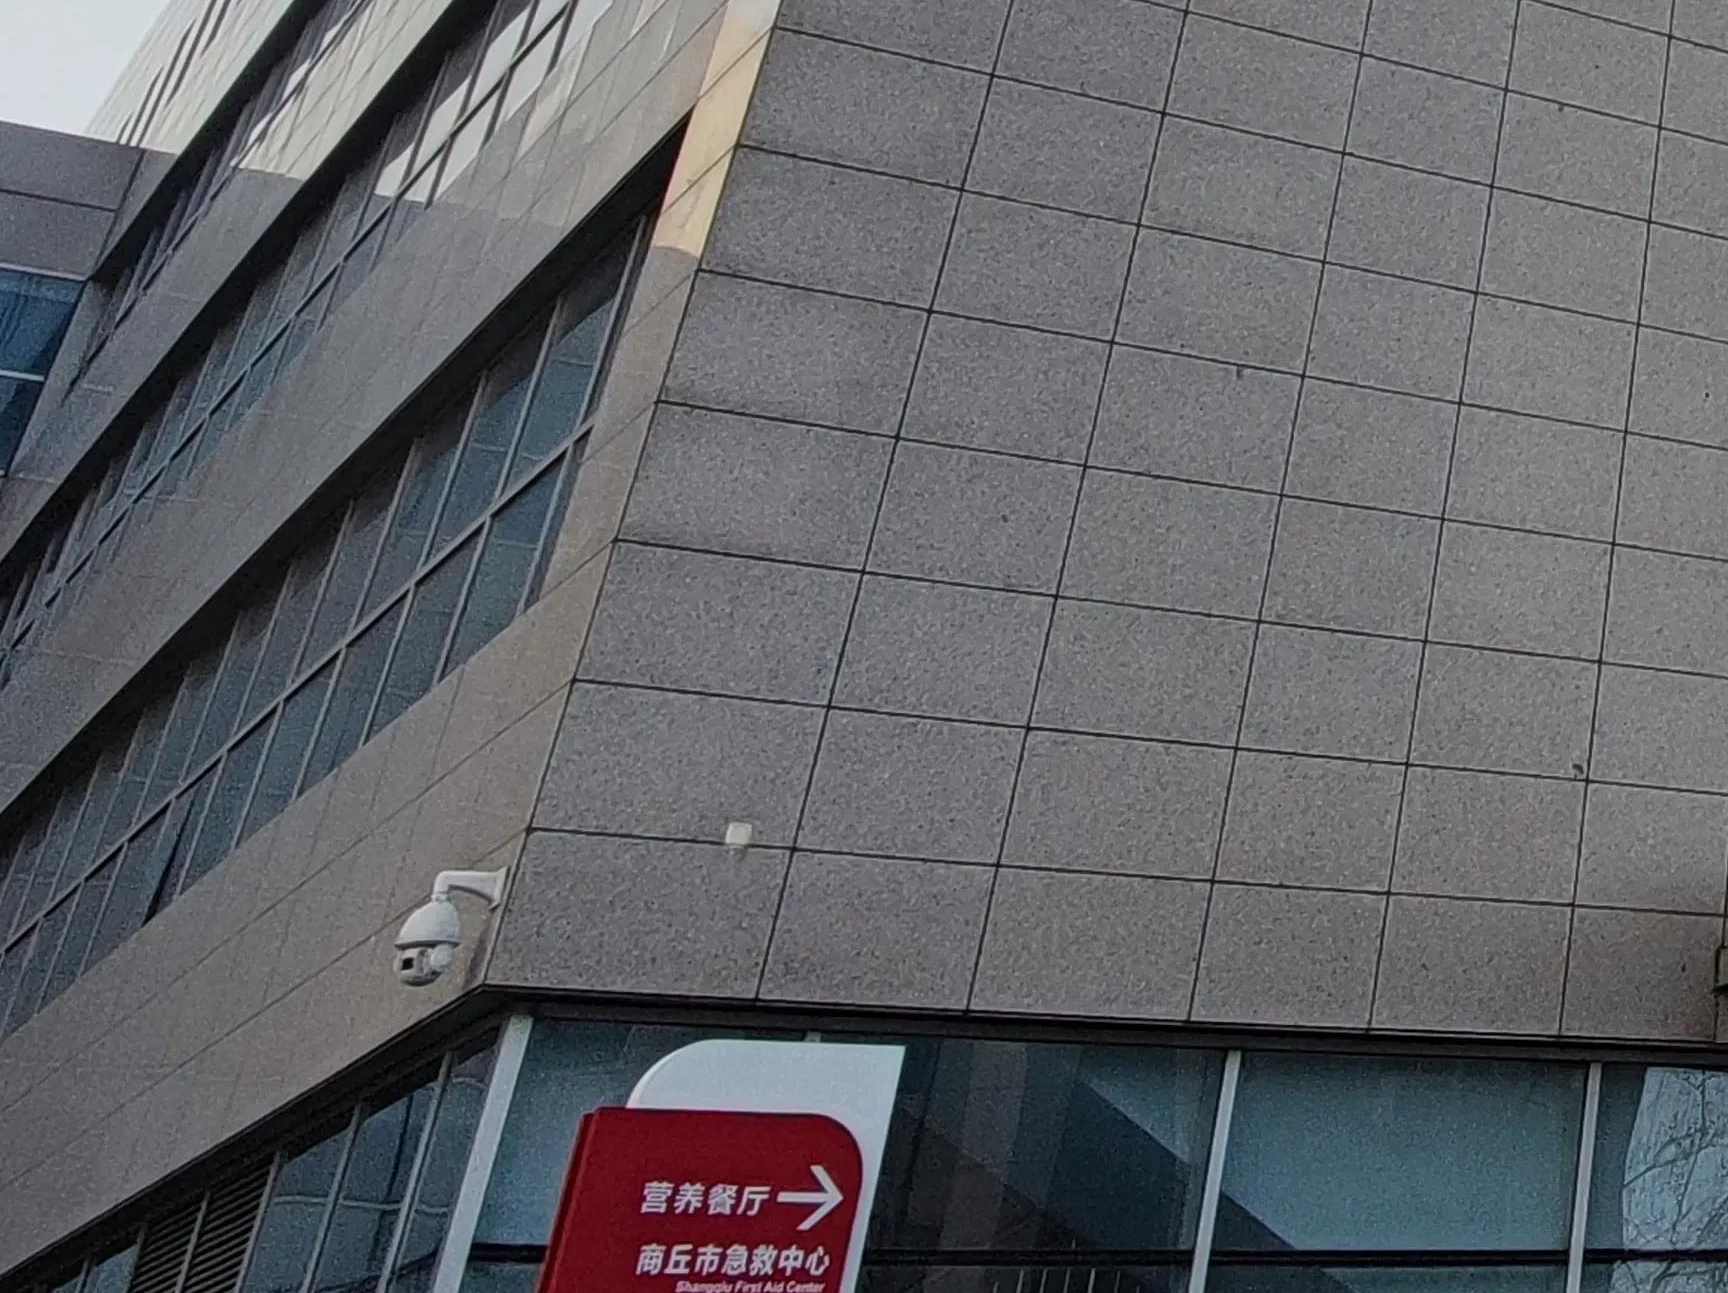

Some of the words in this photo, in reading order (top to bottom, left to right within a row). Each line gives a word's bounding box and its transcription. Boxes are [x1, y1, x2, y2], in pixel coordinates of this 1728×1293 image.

[640, 1181, 772, 1216] 营养餐厅
[635, 1243, 831, 1276] 商丘市急救中心
[763, 1281, 784, 1293] Aid
